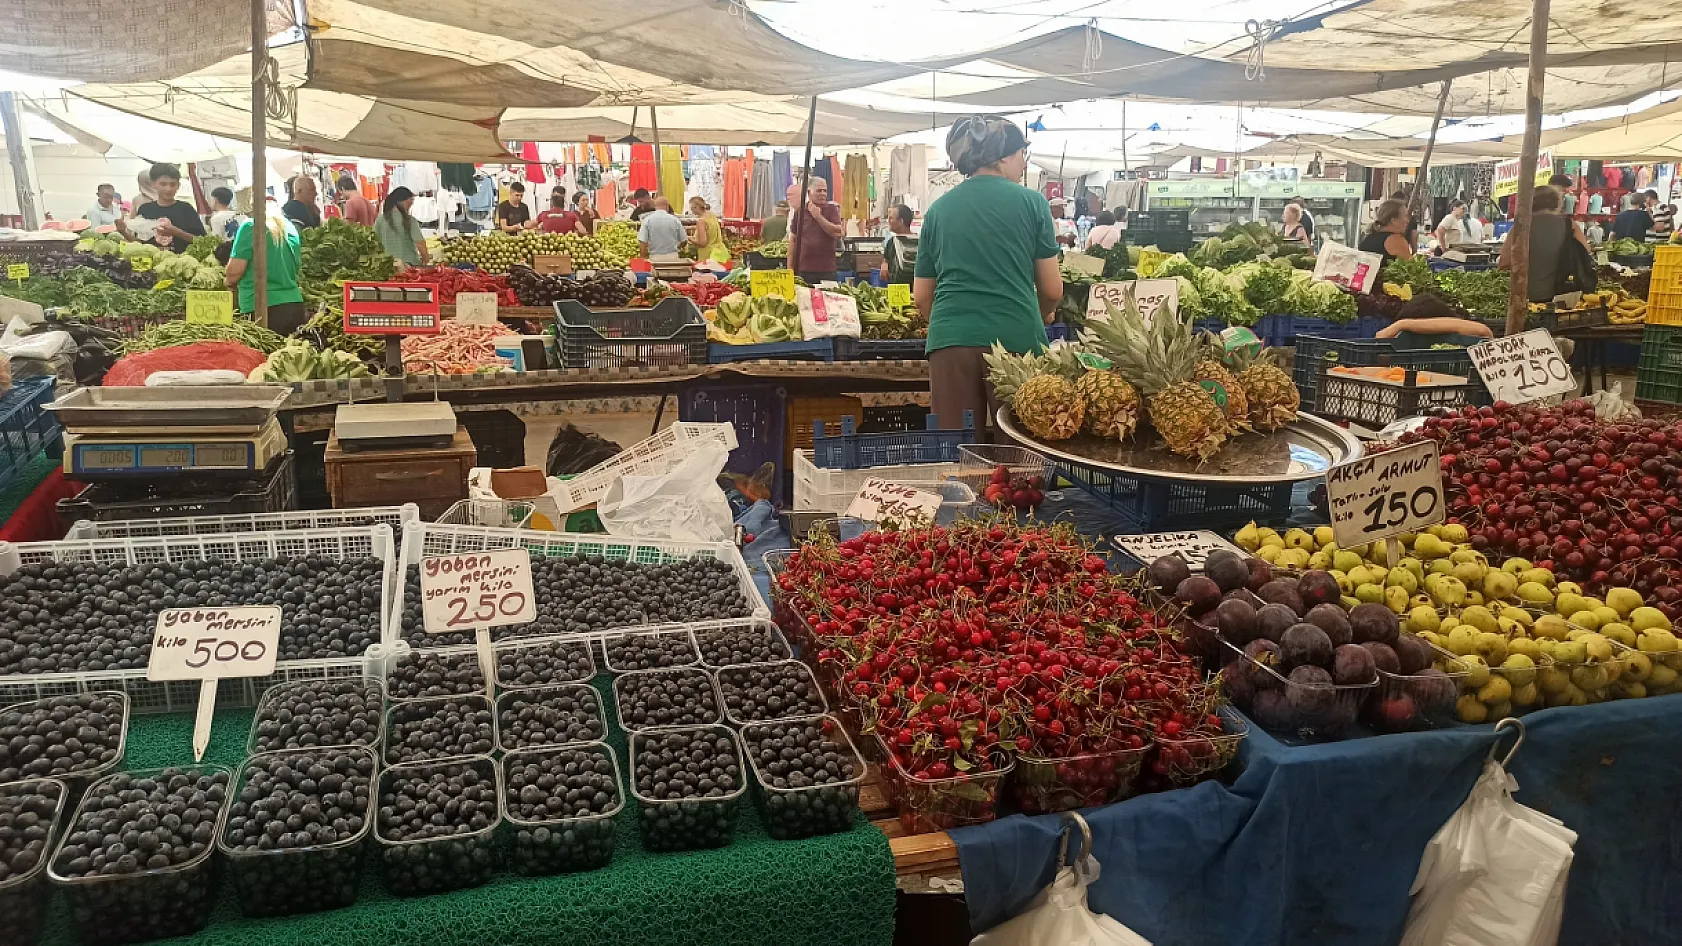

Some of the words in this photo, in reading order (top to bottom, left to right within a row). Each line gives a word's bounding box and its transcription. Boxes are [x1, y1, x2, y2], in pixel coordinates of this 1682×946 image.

[1496, 337, 1530, 354] YORK
[1513, 356, 1568, 390] 150
[1330, 458, 1375, 483] AKÇA
[1377, 453, 1433, 482] ARMUT
[1335, 511, 1354, 523] kilo
[1362, 485, 1437, 533] 150
[460, 564, 521, 584] mersini
[480, 580, 513, 592] kilo
[164, 610, 229, 628] yaban
[446, 592, 526, 627] 250
[206, 615, 274, 631] mersini
[156, 635, 188, 648] kilo
[185, 637, 266, 668] 500
